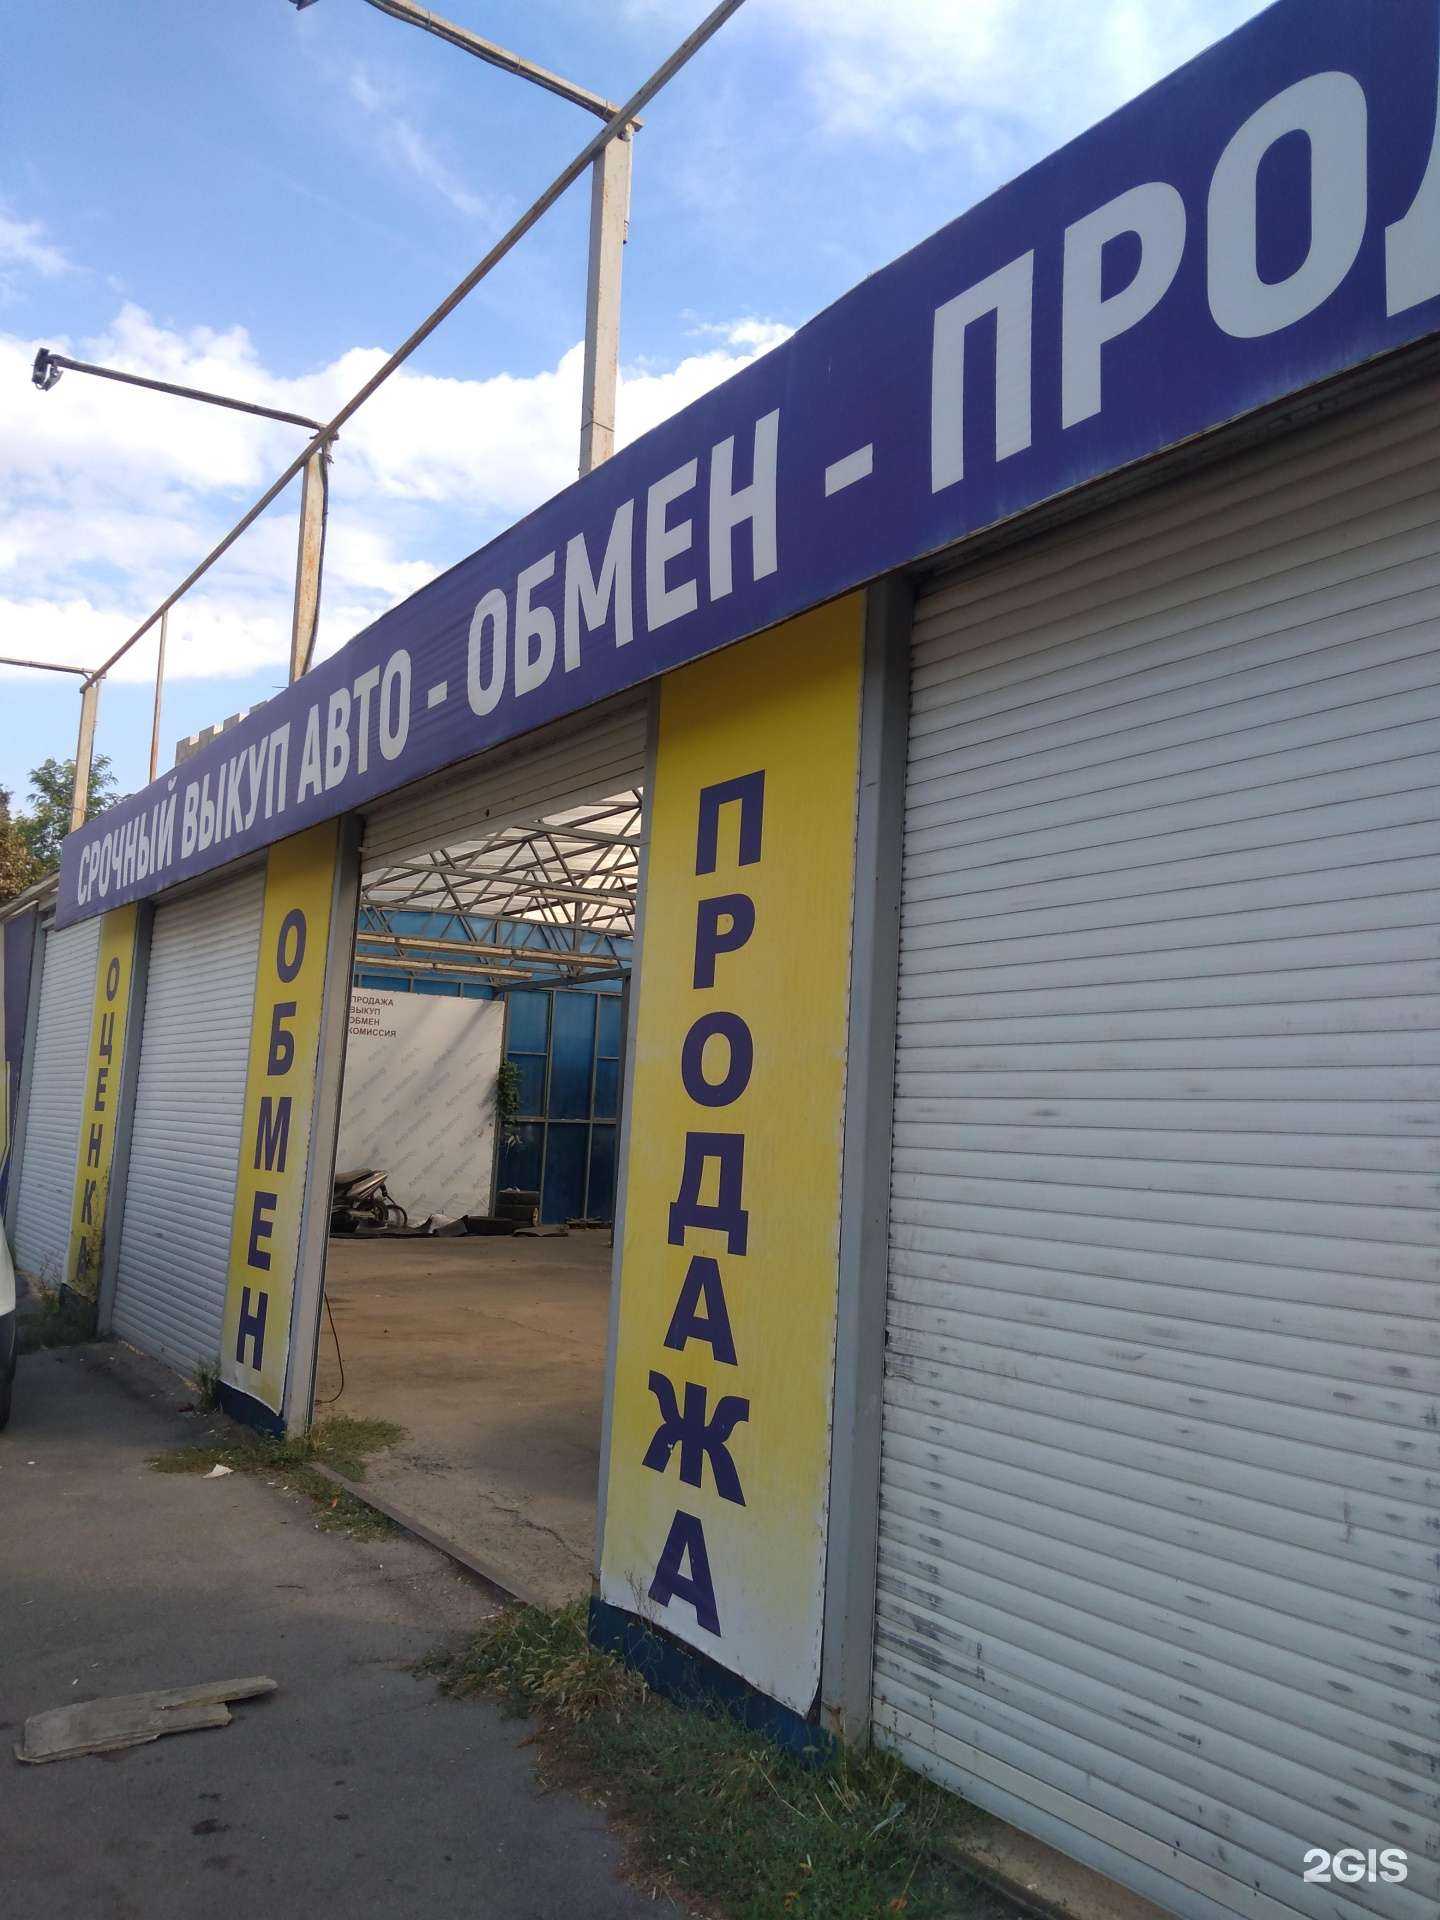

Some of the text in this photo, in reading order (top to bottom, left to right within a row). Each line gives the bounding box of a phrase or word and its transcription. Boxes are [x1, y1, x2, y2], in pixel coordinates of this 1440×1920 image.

[77, 776, 178, 906] СРОЧНЫЙ
[181, 720, 291, 860] ВЫКУП
[297, 649, 412, 804] АВТО
[467, 408, 780, 717] ОБМЕН
[931, 0, 1440, 494] ПРО
[75, 957, 120, 1281] ОЦЕНКА
[235, 908, 307, 1371] ОБМЕН
[642, 769, 765, 1638] ПРОДАЖА
